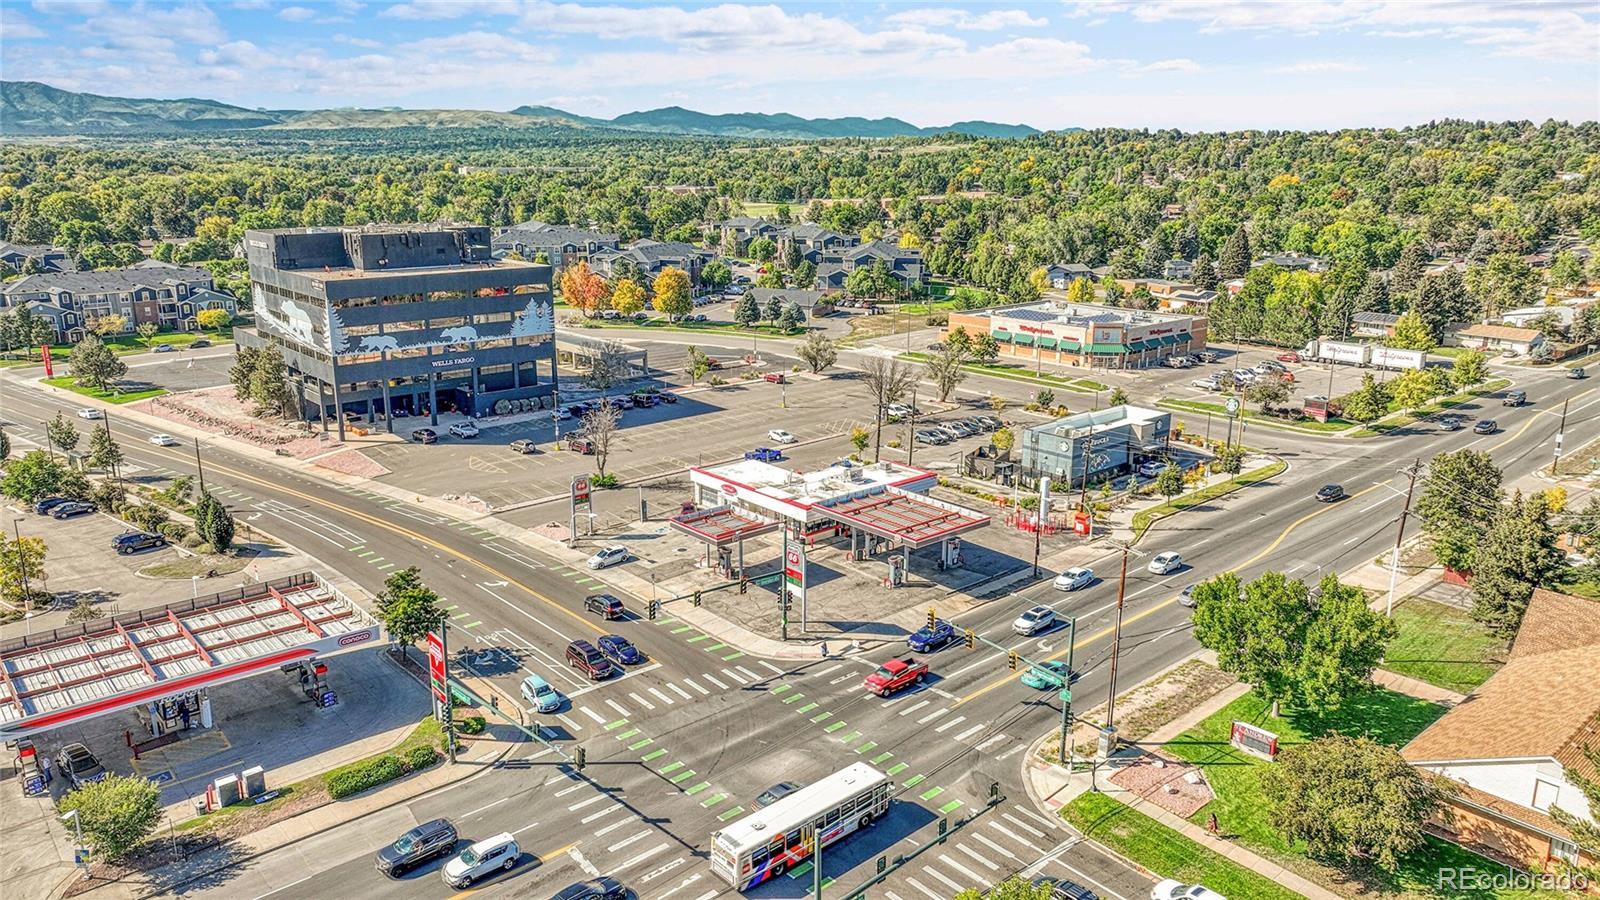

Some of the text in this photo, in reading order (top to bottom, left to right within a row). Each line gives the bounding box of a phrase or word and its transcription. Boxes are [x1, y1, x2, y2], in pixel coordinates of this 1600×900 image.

[454, 356, 475, 365] FARGO
[788, 551, 799, 564] 66
[341, 633, 370, 645] conoco
